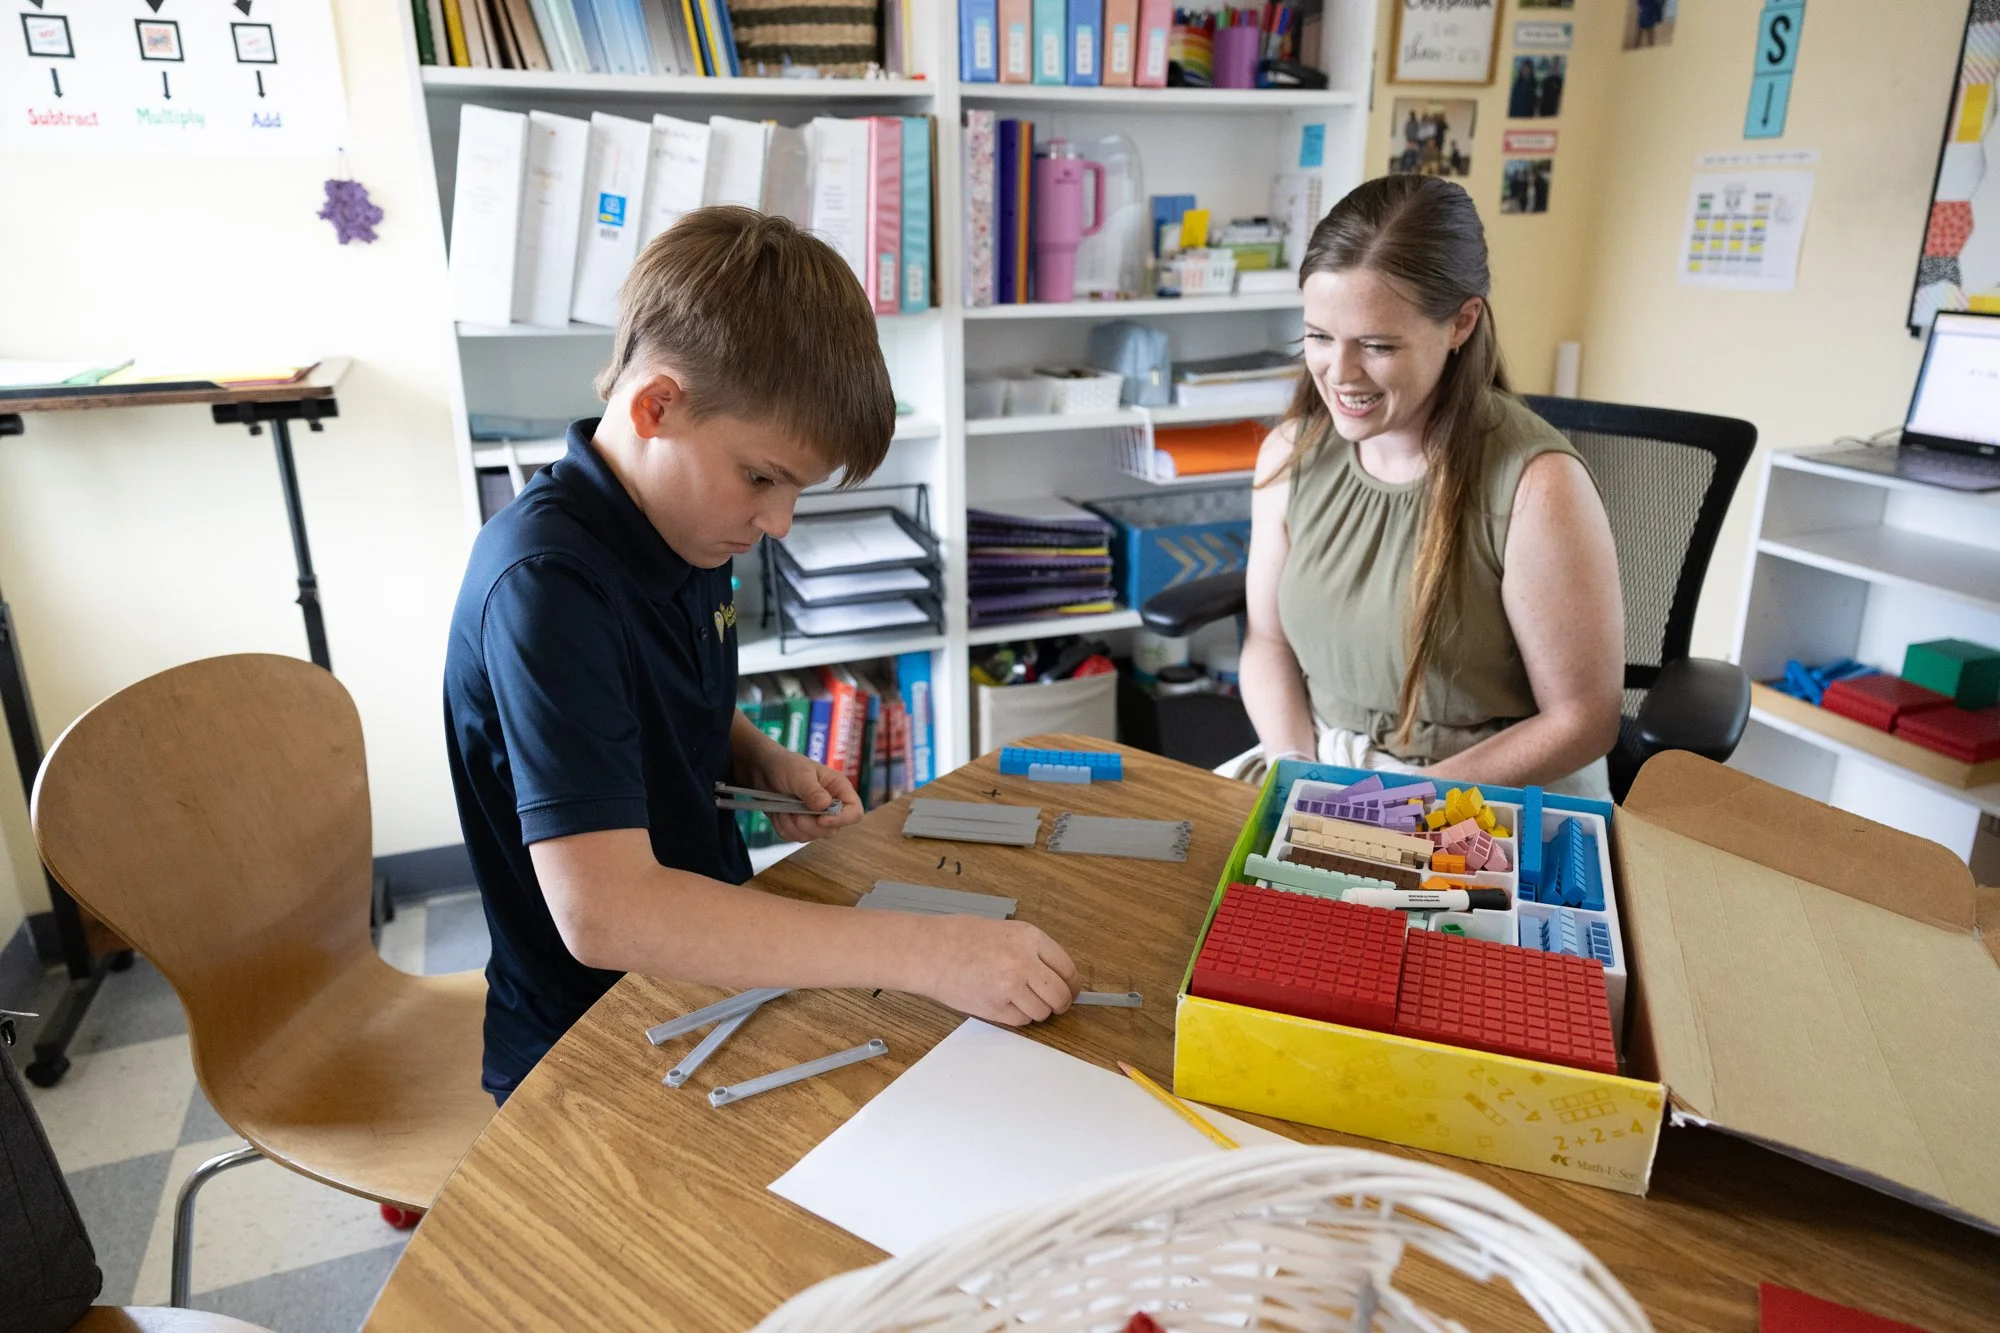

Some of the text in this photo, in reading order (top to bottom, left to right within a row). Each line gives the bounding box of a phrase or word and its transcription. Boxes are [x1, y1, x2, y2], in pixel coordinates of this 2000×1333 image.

[1767, 15, 1791, 64] S
[28, 108, 99, 127] Subtract
[136, 107, 206, 129] Multiply
[252, 112, 282, 128] Add
[1553, 1135, 1570, 1151] 2
[1590, 1127, 1607, 1143] 2
[1630, 1119, 1644, 1134] 4
